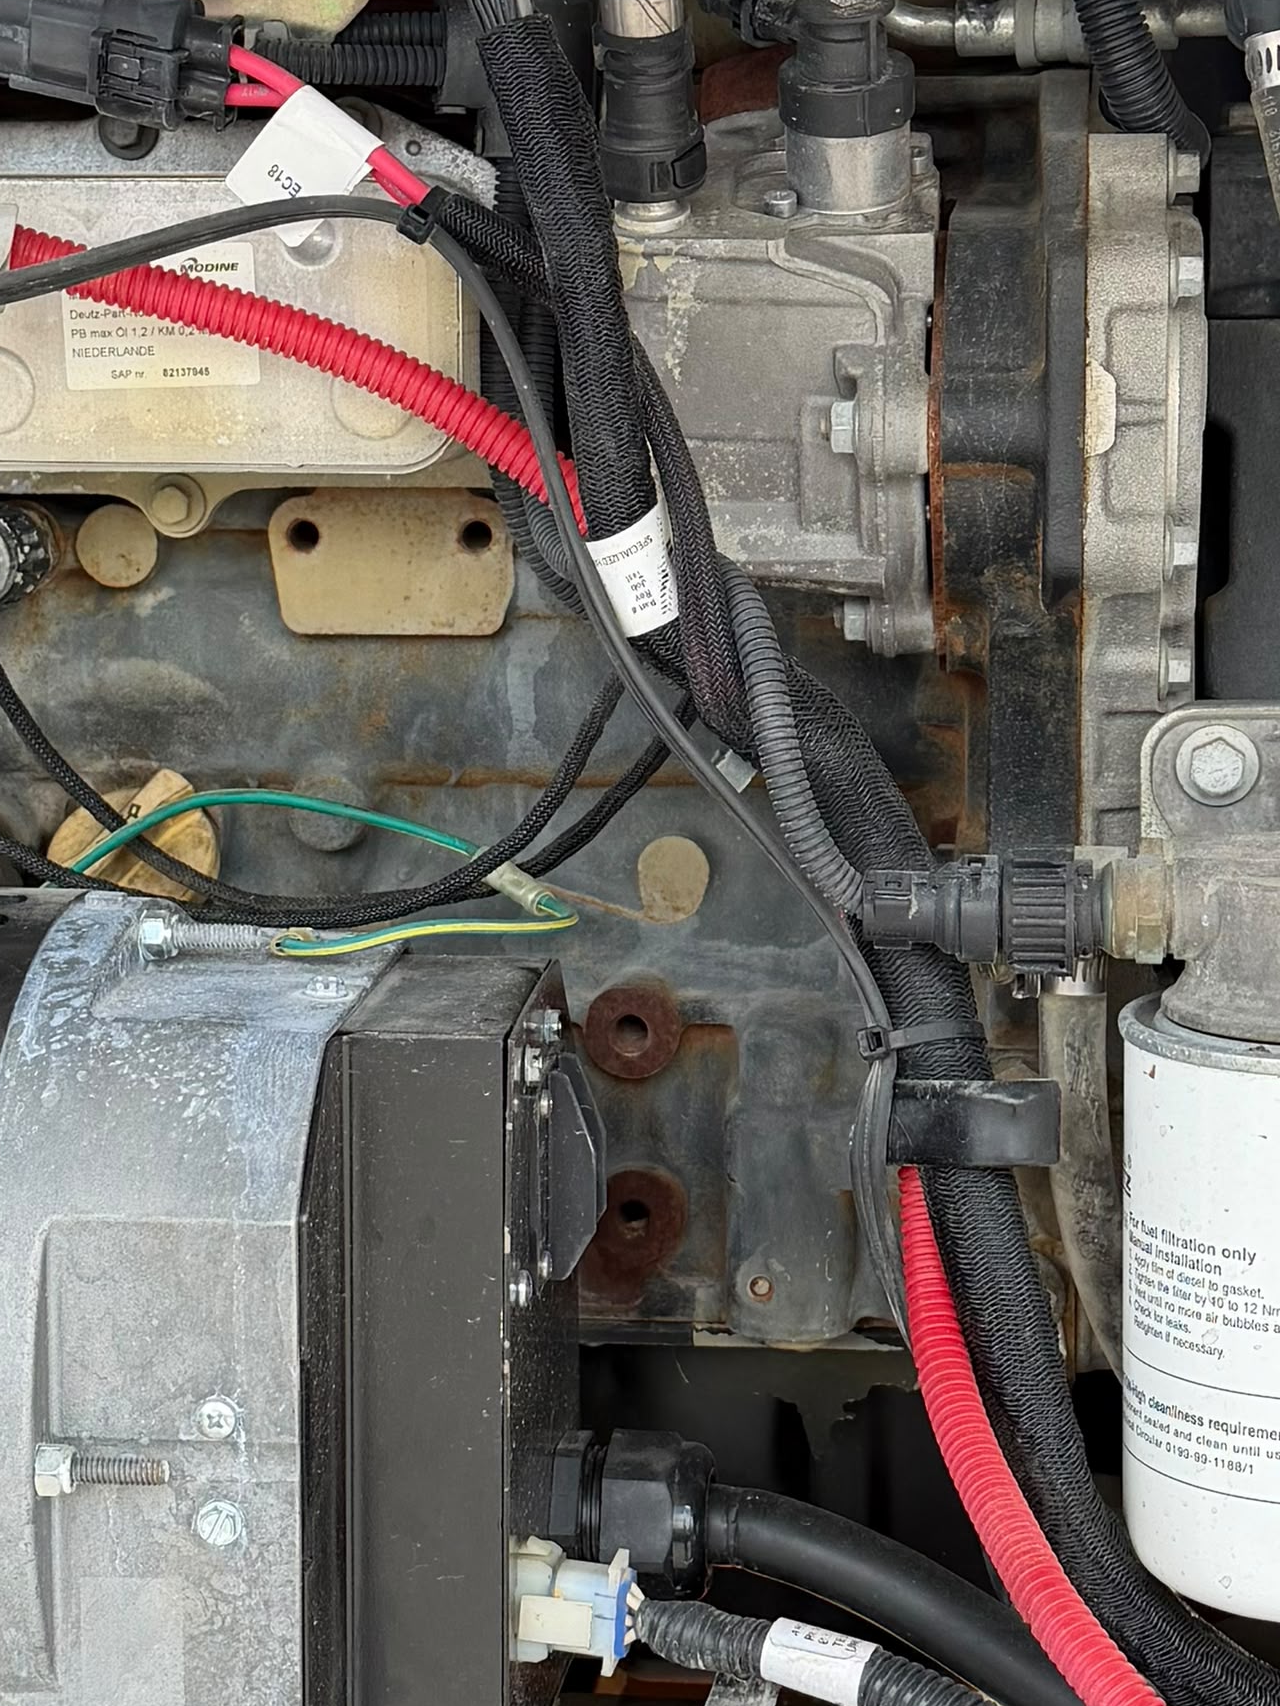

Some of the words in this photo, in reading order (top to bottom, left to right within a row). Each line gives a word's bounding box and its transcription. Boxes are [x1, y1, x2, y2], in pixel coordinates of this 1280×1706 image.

[268, 164, 302, 199] EC18
[180, 262, 239, 273] MODINE
[71, 329, 87, 339] PB
[91, 330, 112, 338] max
[158, 328, 175, 336] KM
[72, 346, 155, 358] NIEDERLANDE
[111, 370, 132, 379] SAP
[1161, 1229, 1216, 1256] filtration
[1222, 1248, 1256, 1265] only
[1208, 1281, 1218, 1292] to
[1228, 1300, 1239, 1312] to
[1244, 1303, 1257, 1314] 12
[1205, 1309, 1218, 1323] air
[1223, 1316, 1269, 1332] bubbles
[1173, 1428, 1192, 1442] and
[1196, 1435, 1228, 1451] clean
[1233, 1444, 1260, 1457] until
